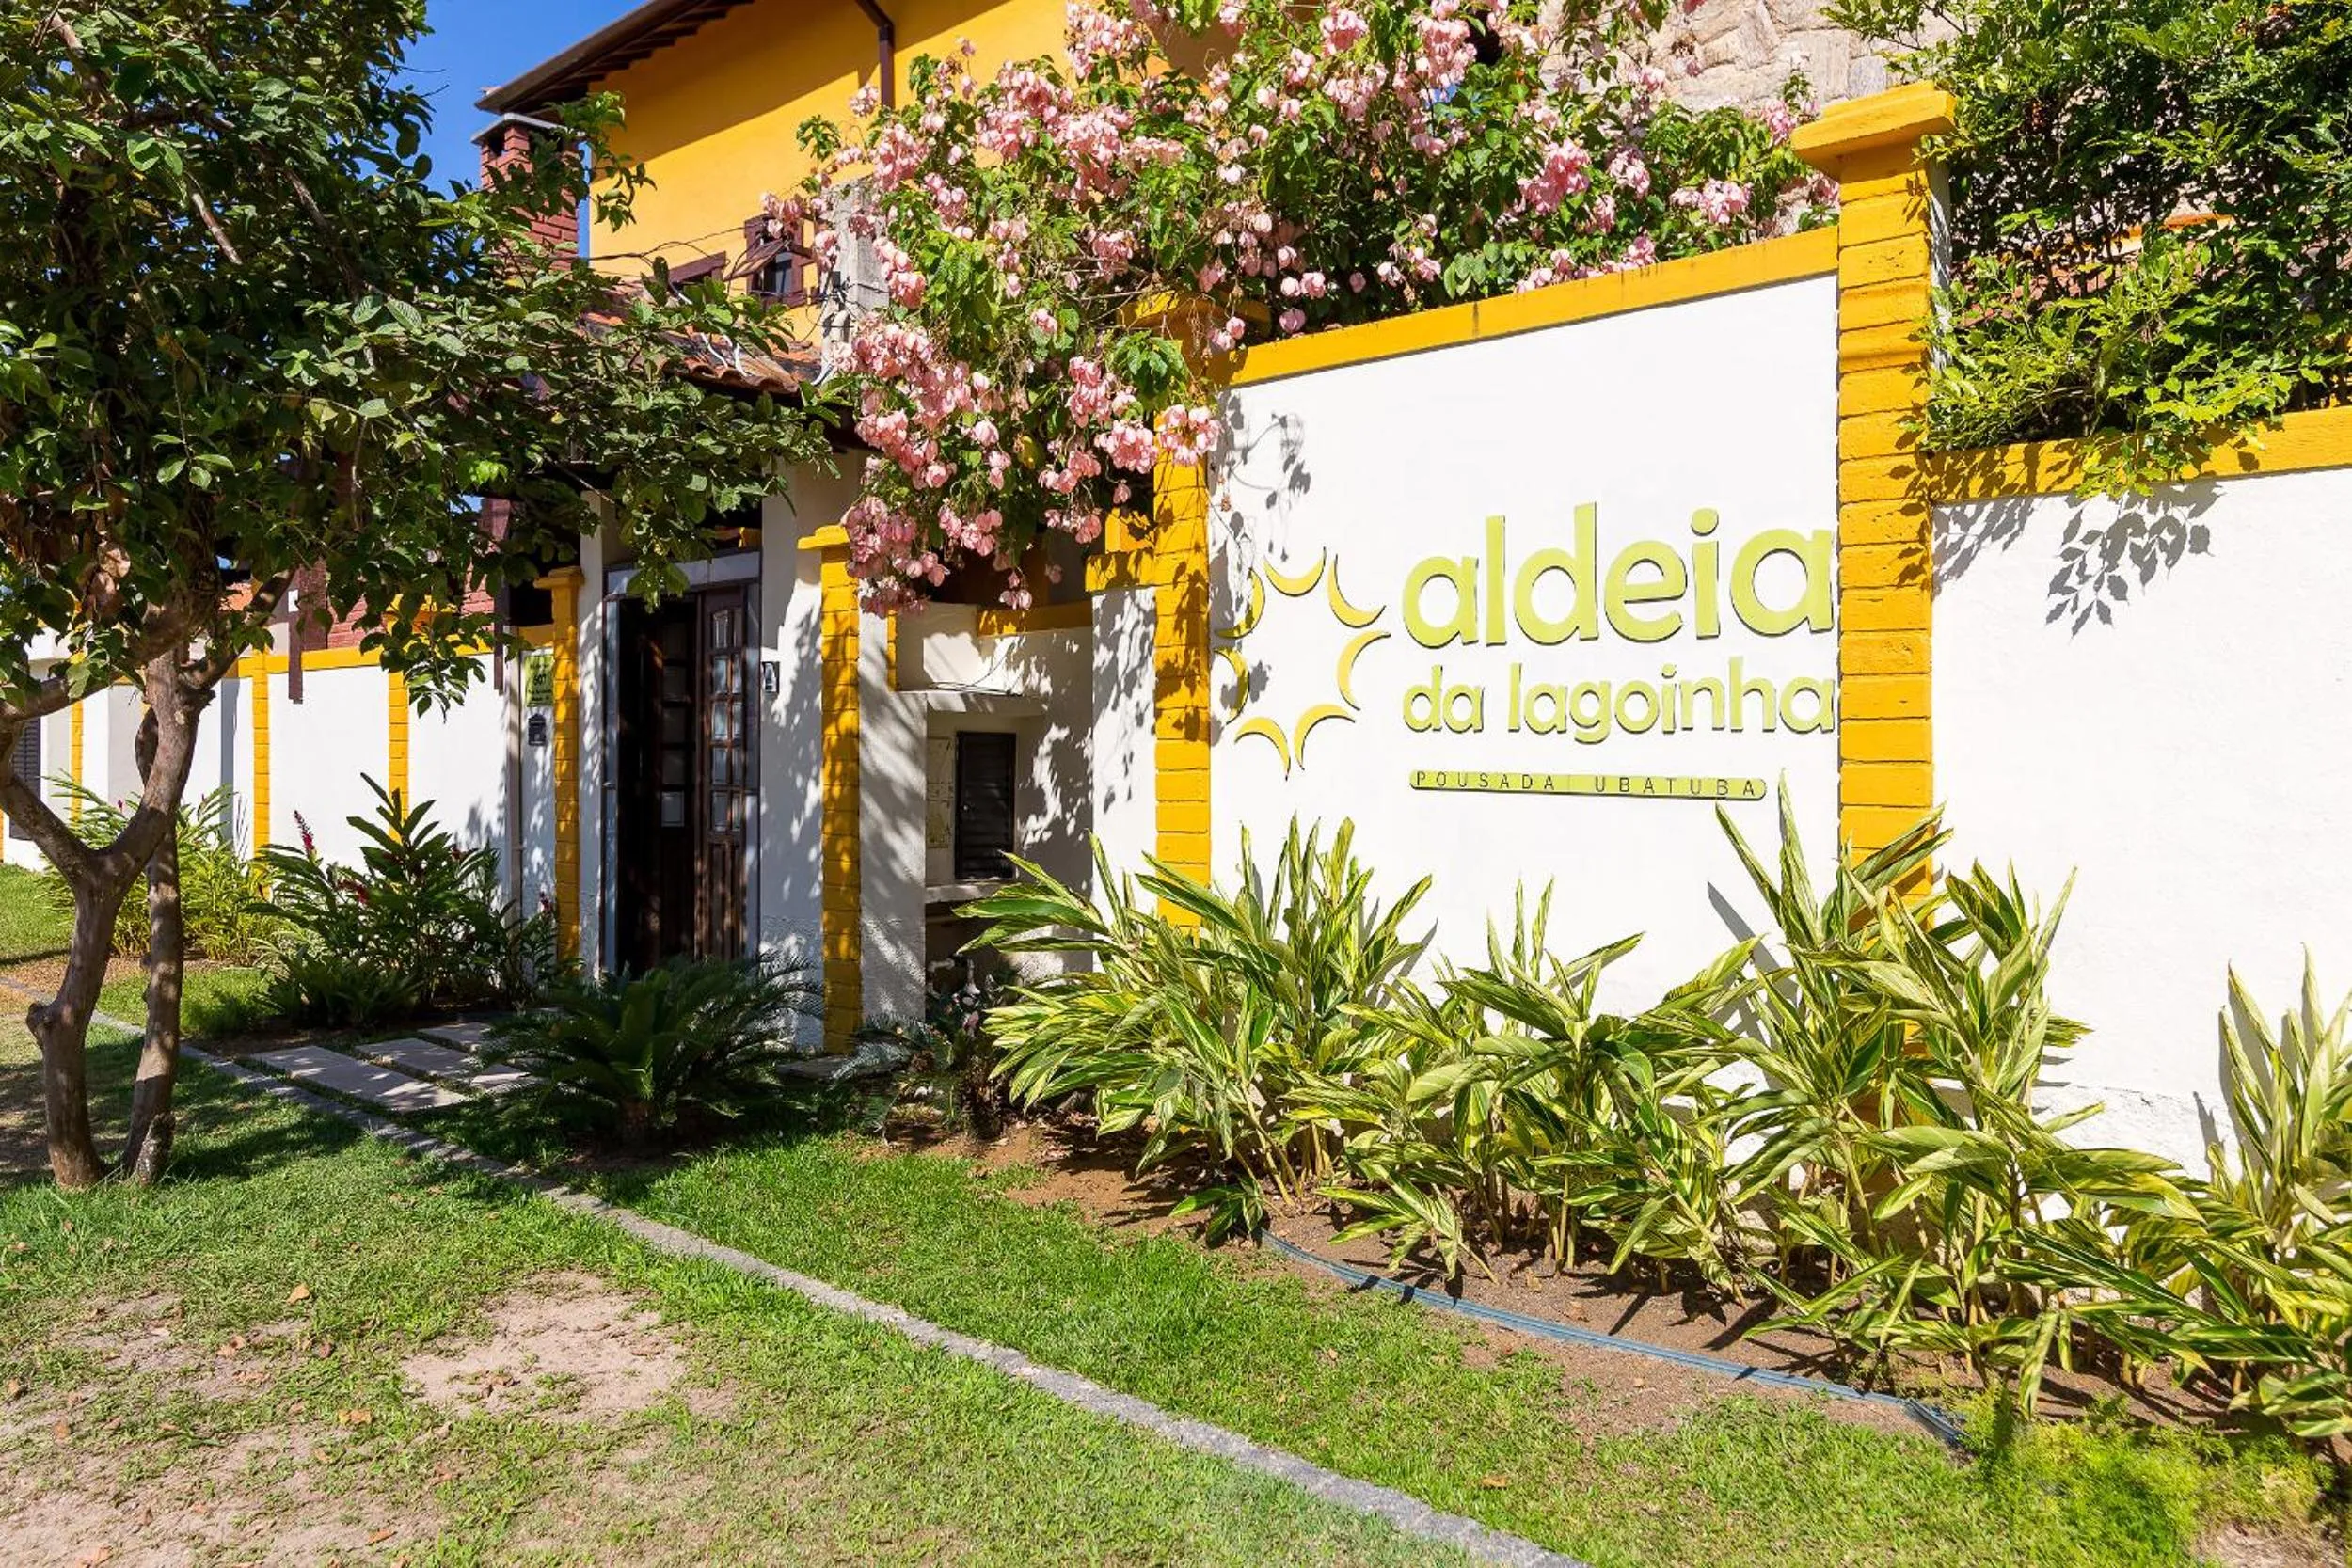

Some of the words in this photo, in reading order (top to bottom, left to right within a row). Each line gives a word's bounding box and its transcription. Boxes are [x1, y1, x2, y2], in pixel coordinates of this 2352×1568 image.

[1402, 501, 1834, 649] aldeia
[1403, 663, 1484, 734] da
[1508, 656, 1835, 745] lagoinha
[1416, 770, 1555, 791] POUSADA
[1595, 775, 1756, 797] UBATUBA
